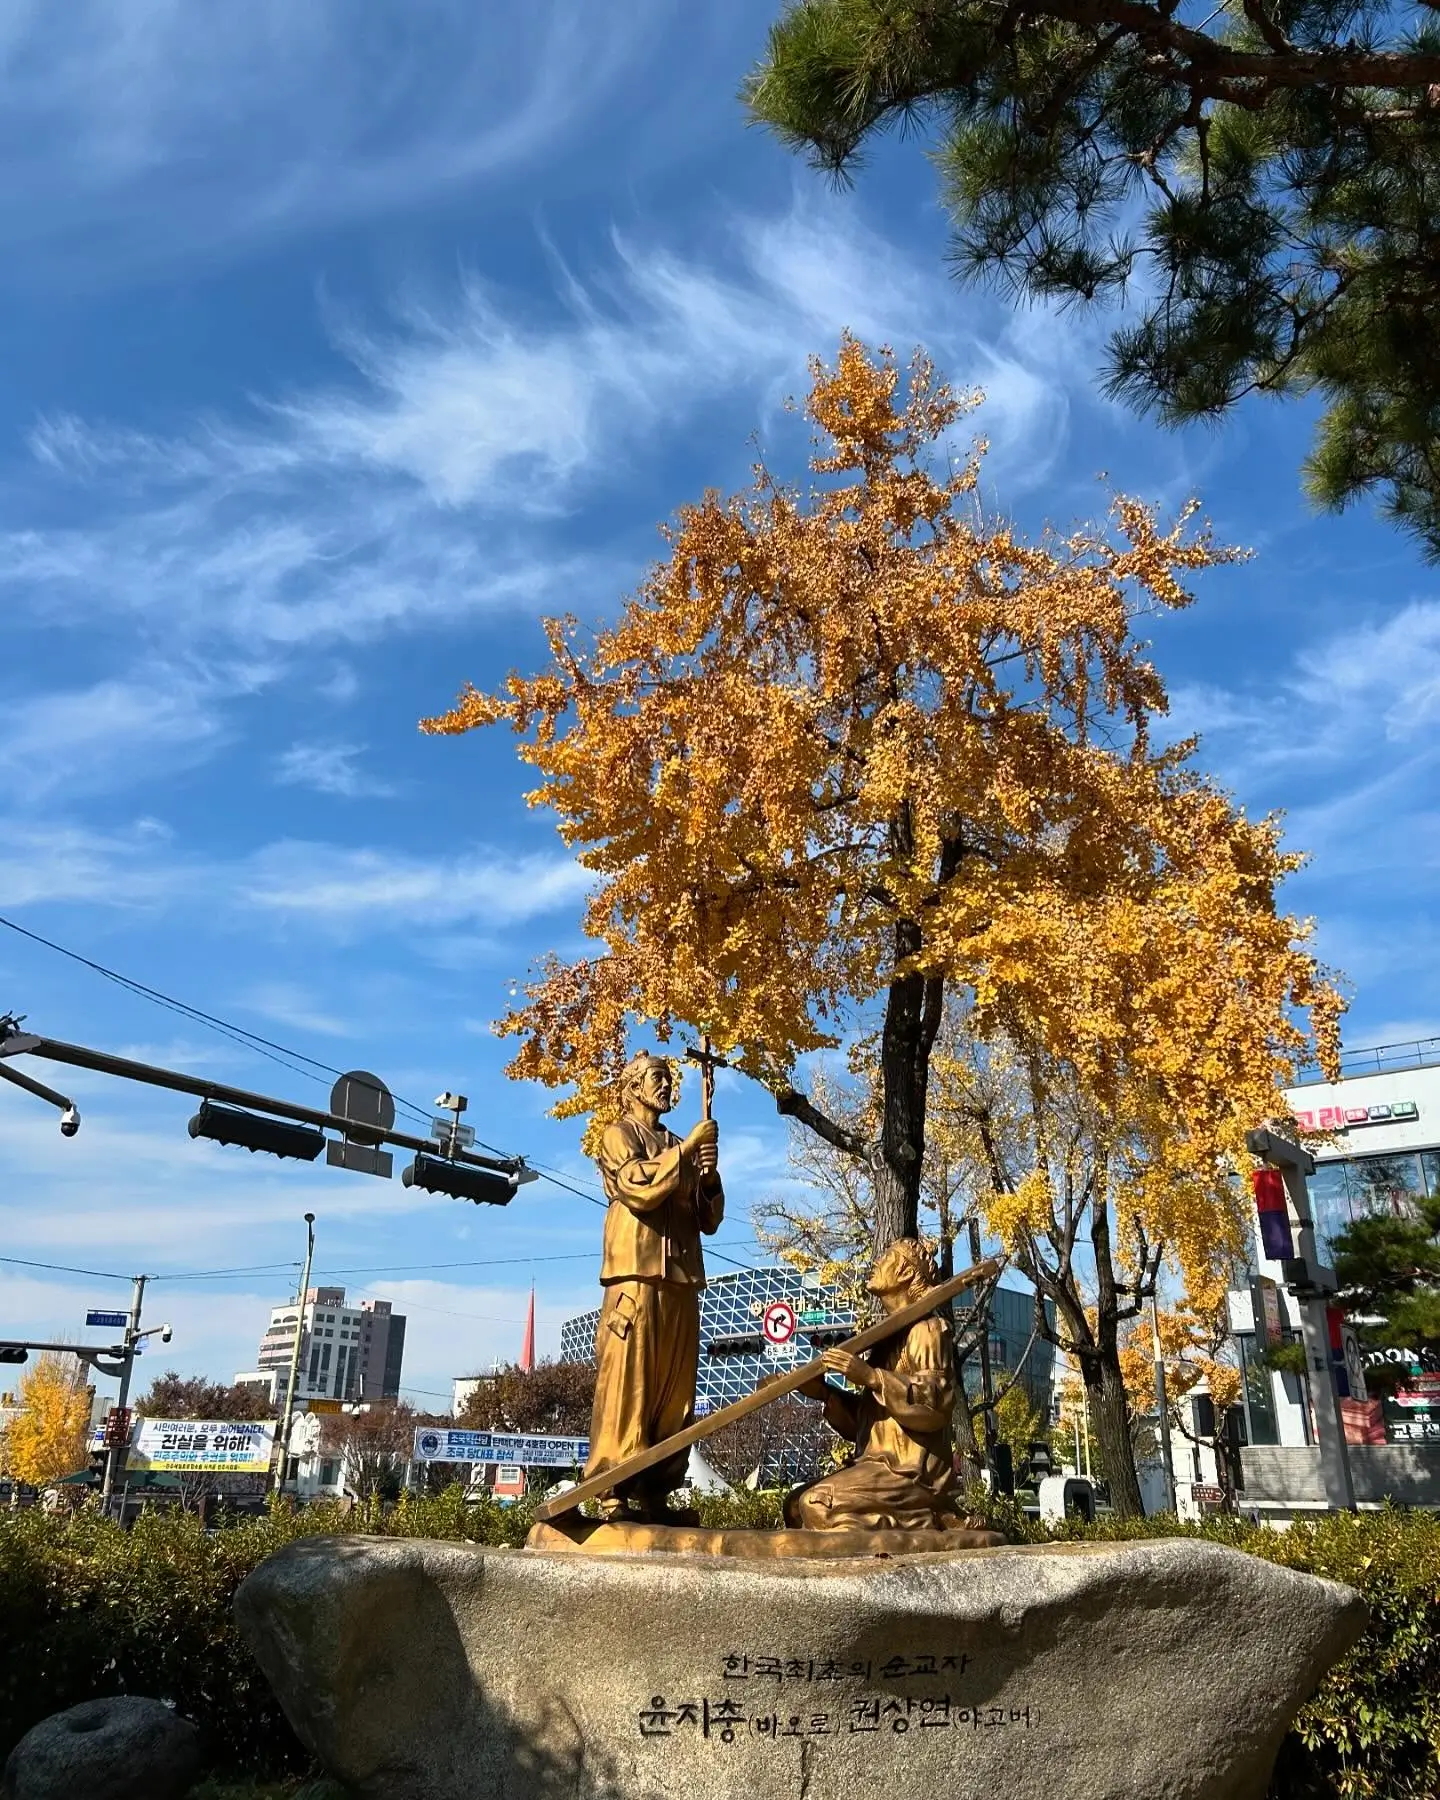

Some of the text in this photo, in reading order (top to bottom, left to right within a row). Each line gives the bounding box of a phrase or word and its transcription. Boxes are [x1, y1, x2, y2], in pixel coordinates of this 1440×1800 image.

[162, 1434, 252, 1451] 진실을 위해!
[451, 1434, 489, 1446] 조국혁신당
[493, 1437, 524, 1448] 탄핵다방
[548, 1441, 574, 1451] OPEN
[446, 1447, 514, 1461] 조국 당대표 참석
[880, 1653, 972, 1679] 순교자
